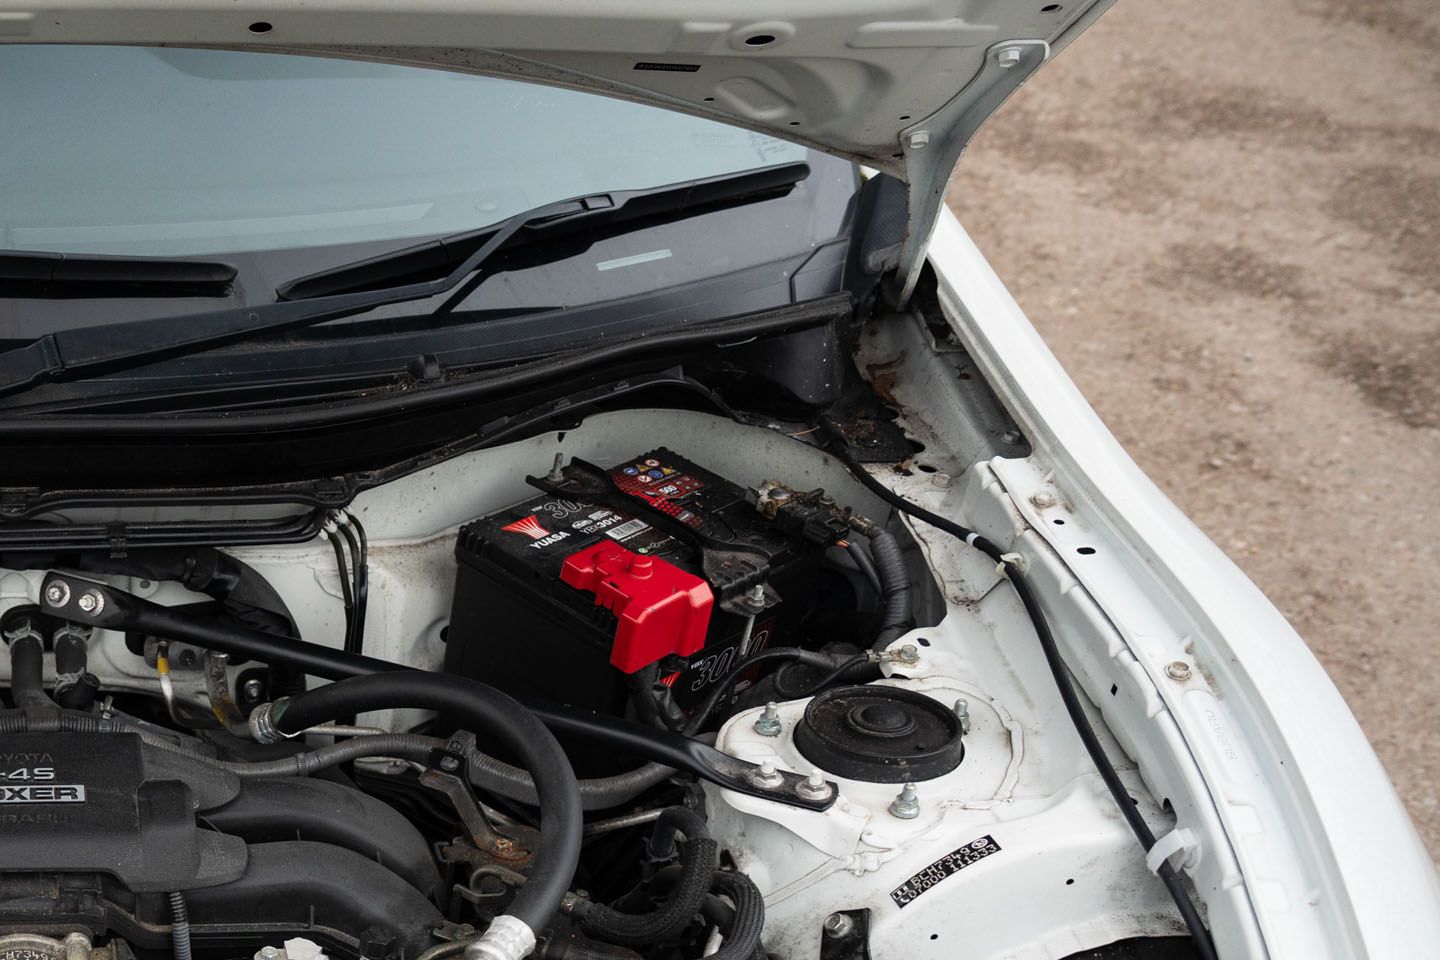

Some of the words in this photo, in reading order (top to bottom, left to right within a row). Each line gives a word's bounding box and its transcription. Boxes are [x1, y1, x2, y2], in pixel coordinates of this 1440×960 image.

[528, 530, 572, 551] YUASA
[908, 871, 947, 899] 07000
[949, 844, 998, 872] 111333
[910, 847, 972, 887] BCH7349
